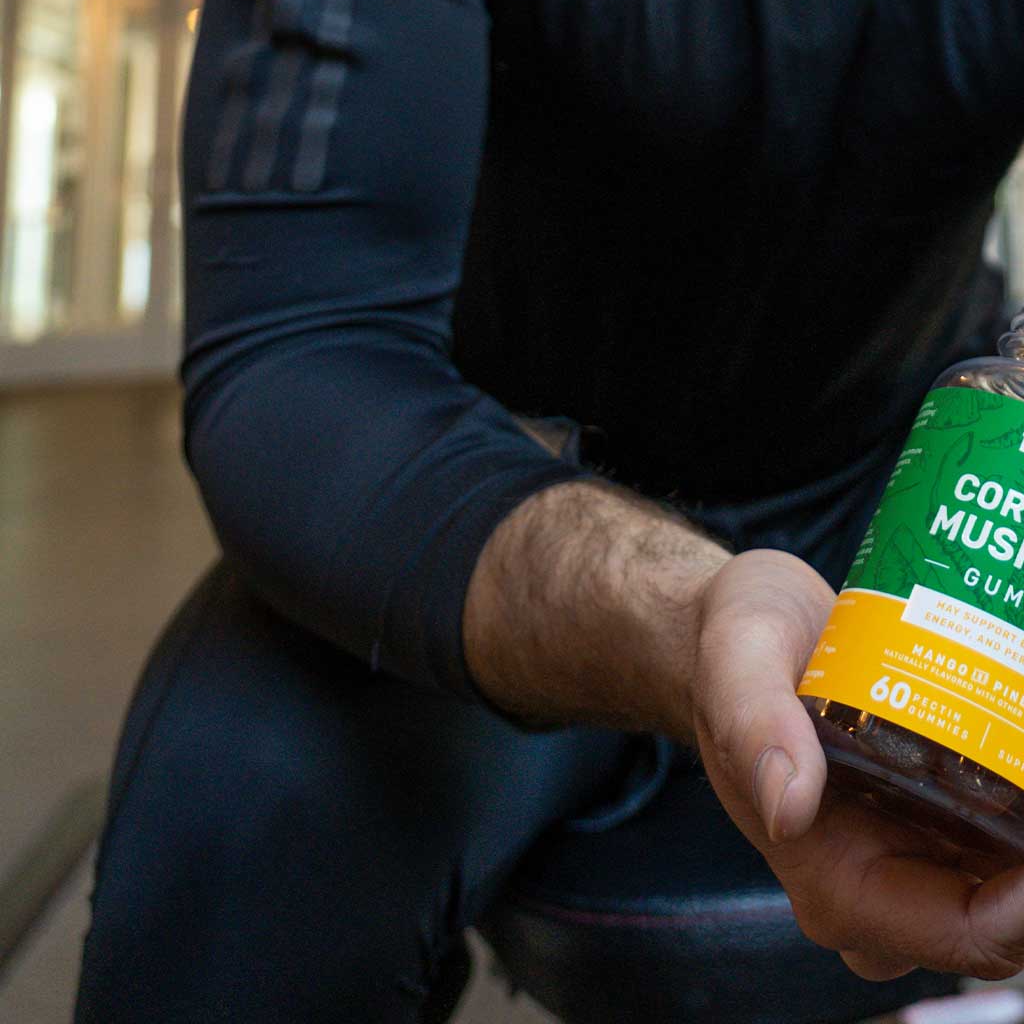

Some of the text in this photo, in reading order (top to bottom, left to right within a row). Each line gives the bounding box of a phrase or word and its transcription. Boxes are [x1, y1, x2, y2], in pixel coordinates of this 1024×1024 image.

[924, 611, 973, 641] ENERGY,
[977, 633, 1000, 651] AND
[936, 600, 960, 616] MAY
[962, 609, 1017, 645] SUPPORT
[911, 643, 968, 675] MANGO
[870, 675, 961, 722] 60 PECTIN
[883, 648, 929, 671] NATURALLY
[930, 666, 974, 691] FLAVORED
[975, 687, 996, 703] WITH
[997, 698, 1023, 718] OTHER
[908, 704, 969, 740] GUMMIES
